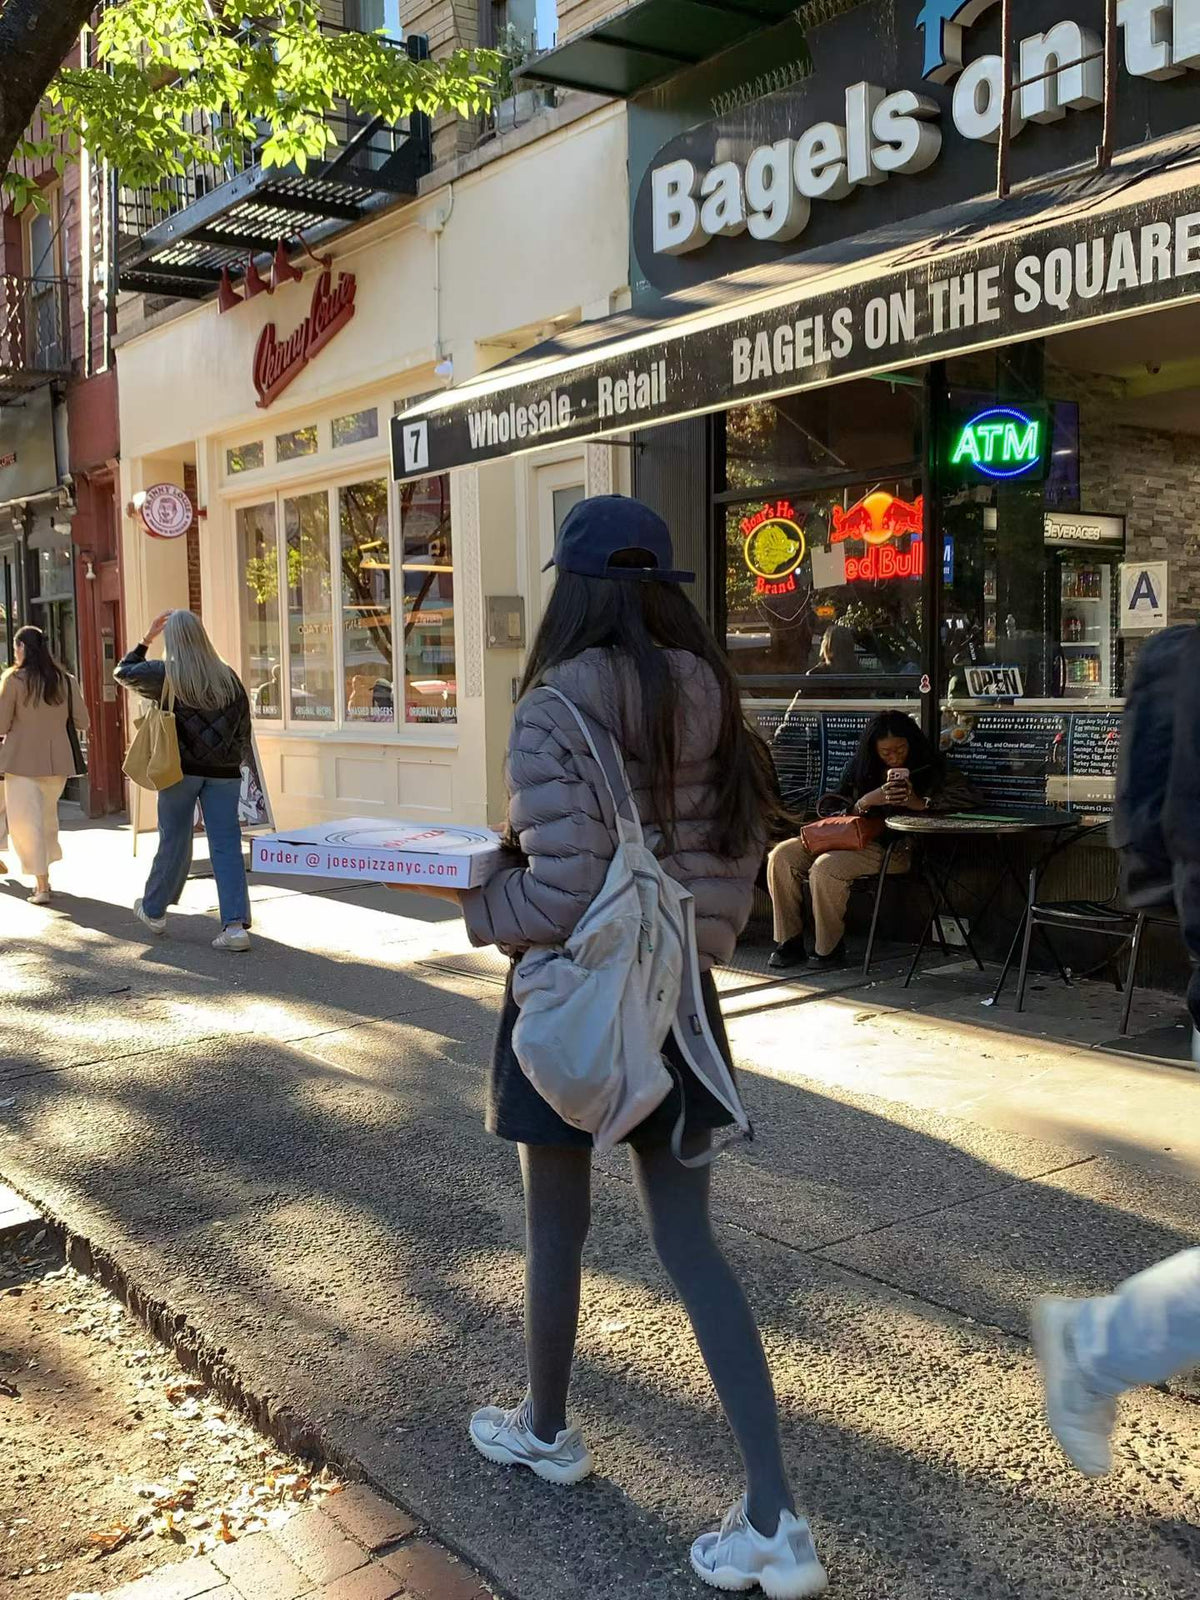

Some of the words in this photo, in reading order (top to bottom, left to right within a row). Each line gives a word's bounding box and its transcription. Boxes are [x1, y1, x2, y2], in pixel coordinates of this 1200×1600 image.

[651, 81, 940, 255] Bagels
[951, 20, 1102, 143] on
[732, 307, 853, 385] BAGELS
[864, 288, 917, 350] ON
[929, 267, 1001, 334] THE
[1013, 214, 1200, 313] SQUARE
[409, 429, 422, 464] 7
[468, 391, 572, 449] Wholesale
[597, 360, 667, 417] Retail
[951, 421, 1040, 464] ATM
[740, 503, 775, 535] Boar's
[845, 547, 876, 580] ed
[879, 541, 923, 578] Bull
[756, 574, 796, 594] Brand
[1128, 571, 1159, 610] A
[969, 669, 1019, 695] OPEN
[260, 848, 298, 864] Order
[306, 852, 321, 868] @
[327, 853, 458, 877] joespizzanyc.com
